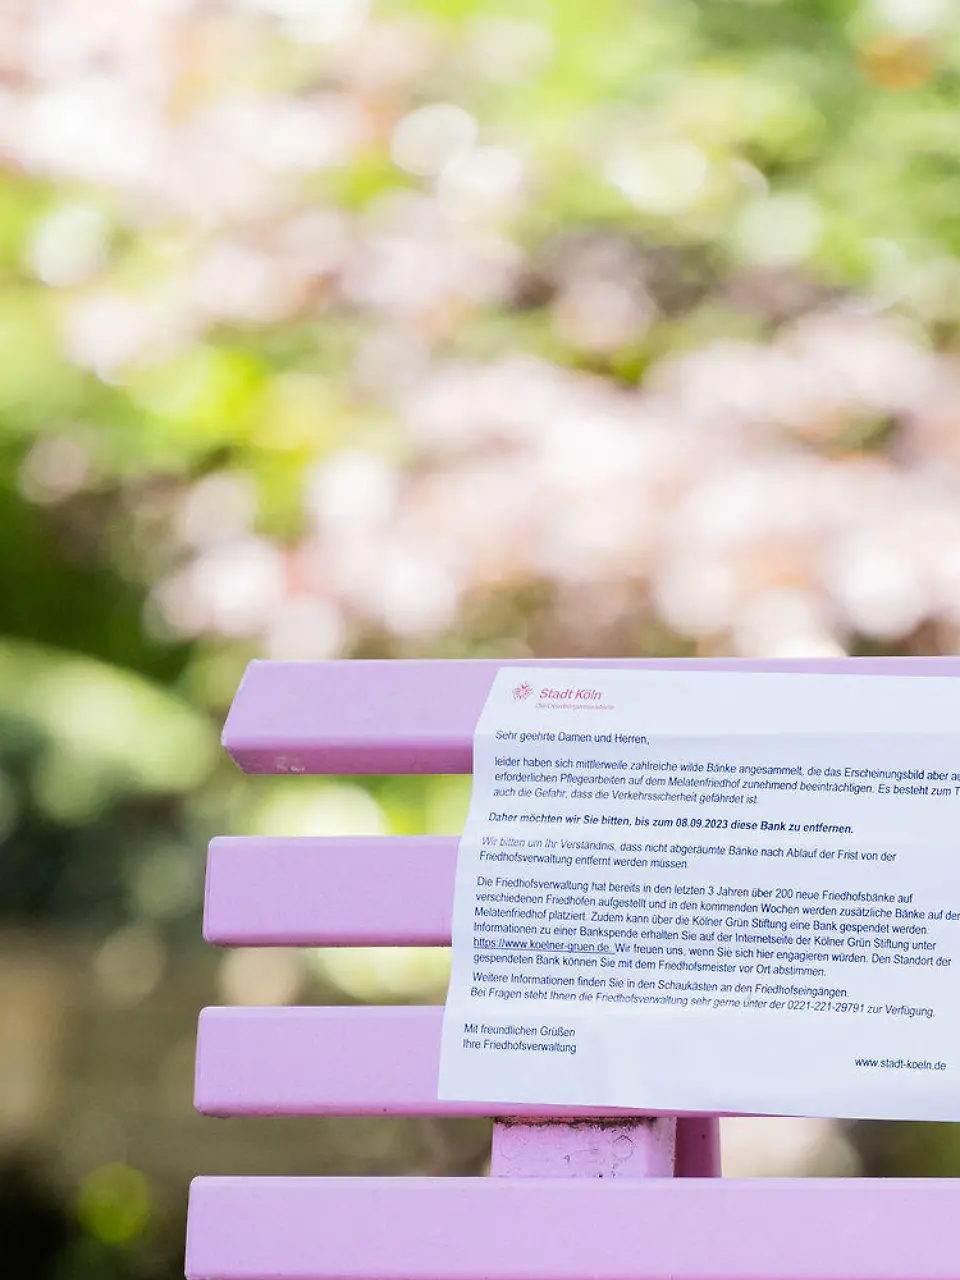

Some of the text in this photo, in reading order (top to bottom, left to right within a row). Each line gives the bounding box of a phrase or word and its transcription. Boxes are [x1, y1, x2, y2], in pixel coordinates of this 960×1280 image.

[540, 688, 602, 700] Stadt Köln
[496, 730, 650, 745] Sehr geehrte Damen und Herren,
[495, 757, 520, 767] leider
[523, 757, 552, 768] haben
[554, 758, 574, 768] sich
[576, 760, 628, 771] mittlerweile
[630, 760, 678, 772] zahlreiche
[680, 762, 704, 772] wilde
[807, 766, 822, 777] die
[824, 767, 842, 777] das
[844, 767, 925, 784] Erscheinungsbild
[927, 769, 948, 781] aber
[494, 787, 697, 803] auch die dass die Verkehrssicherheit
[495, 772, 558, 784] erforderlichen
[560, 773, 626, 787] Pflegearbeiten
[628, 775, 643, 786] auf
[645, 776, 666, 786] dem
[668, 776, 740, 788] Melatenfriedhof
[742, 778, 798, 790] zunehmend
[878, 783, 891, 793] Es
[893, 785, 929, 795] besteht
[931, 788, 952, 796] zum
[489, 812, 517, 822] Daher
[520, 813, 562, 823] möchten
[565, 815, 581, 824] wir
[584, 815, 599, 824] Sie
[601, 815, 632, 827] bitten,
[635, 816, 650, 826] bis
[676, 818, 728, 829] 08.09.2023
[731, 820, 758, 830] diese
[761, 821, 786, 831] Bank
[789, 824, 801, 832] zu
[803, 822, 853, 834] entfernen.
[480, 851, 648, 867] Friedhofsverwaltung entfernt werden
[620, 842, 643, 853] dass
[645, 843, 668, 852] nicht
[761, 847, 784, 857] nach
[786, 848, 817, 858] Ablauf
[819, 849, 835, 859] der
[838, 849, 859, 860] Frist
[881, 851, 896, 861] der
[477, 876, 913, 903] Die Friedhofsverwaltung hat bereits in den letzten 3 Jahren über 200 neue auf
[476, 892, 544, 904] verschiedenen
[598, 897, 646, 911] aufgestellt
[648, 899, 667, 909] und
[669, 899, 678, 909] in
[680, 900, 698, 910] den
[700, 901, 759, 912] kommenden
[760, 903, 800, 914] Wochen
[802, 904, 838, 916] werden
[928, 910, 943, 920] auf
[475, 907, 546, 921] Melatenfriedhof
[591, 911, 624, 922] Zudem
[626, 913, 650, 925] kann
[651, 914, 673, 924] über
[675, 915, 690, 926] die
[751, 917, 788, 932] Stiftung
[790, 920, 811, 930] eine
[813, 920, 838, 931] Bank
[839, 921, 890, 935] gespendet
[474, 922, 538, 935] Informationen
[540, 924, 551, 936] zu
[554, 925, 577, 937] einer
[579, 926, 639, 942] Bankspende
[641, 928, 680, 940] erhalten
[681, 929, 697, 941] Sie
[700, 931, 715, 941] auf
[717, 932, 733, 942] der
[735, 933, 794, 945] Internetseite
[796, 935, 811, 945] der
[874, 938, 910, 952] Stiftung
[912, 941, 936, 950] unter
[474, 954, 534, 968] gespendeten
[536, 955, 560, 968] Bank
[600, 957, 616, 968] Sie
[618, 958, 633, 968] mit
[635, 959, 656, 969] dem
[658, 959, 736, 972] Friedhofsmeister
[739, 962, 754, 974] vor
[756, 963, 771, 974] Ort
[613, 943, 631, 954] Wir
[633, 944, 664, 955] freuen
[688, 946, 715, 956] wenn
[717, 946, 733, 957] Sie
[735, 948, 754, 959] sich
[756, 948, 774, 959] hier
[776, 951, 829, 963] engagieren
[872, 953, 891, 964] Den
[894, 954, 934, 966] Standort
[936, 957, 951, 966] der
[473, 972, 753, 994] Weitere Informationen finden Sie in den an den
[471, 986, 486, 997] Bei
[489, 987, 522, 1000] Fragen
[524, 988, 548, 999] steht
[787, 1000, 864, 1012] 0221-221-29791
[867, 1005, 883, 1014] zur
[464, 1023, 479, 1034] Mit
[480, 1024, 538, 1036] freundlichen
[463, 1039, 577, 1055] Ihre Friedhofsverwaltung
[855, 1059, 946, 1070] www.stadt-koeln.de
